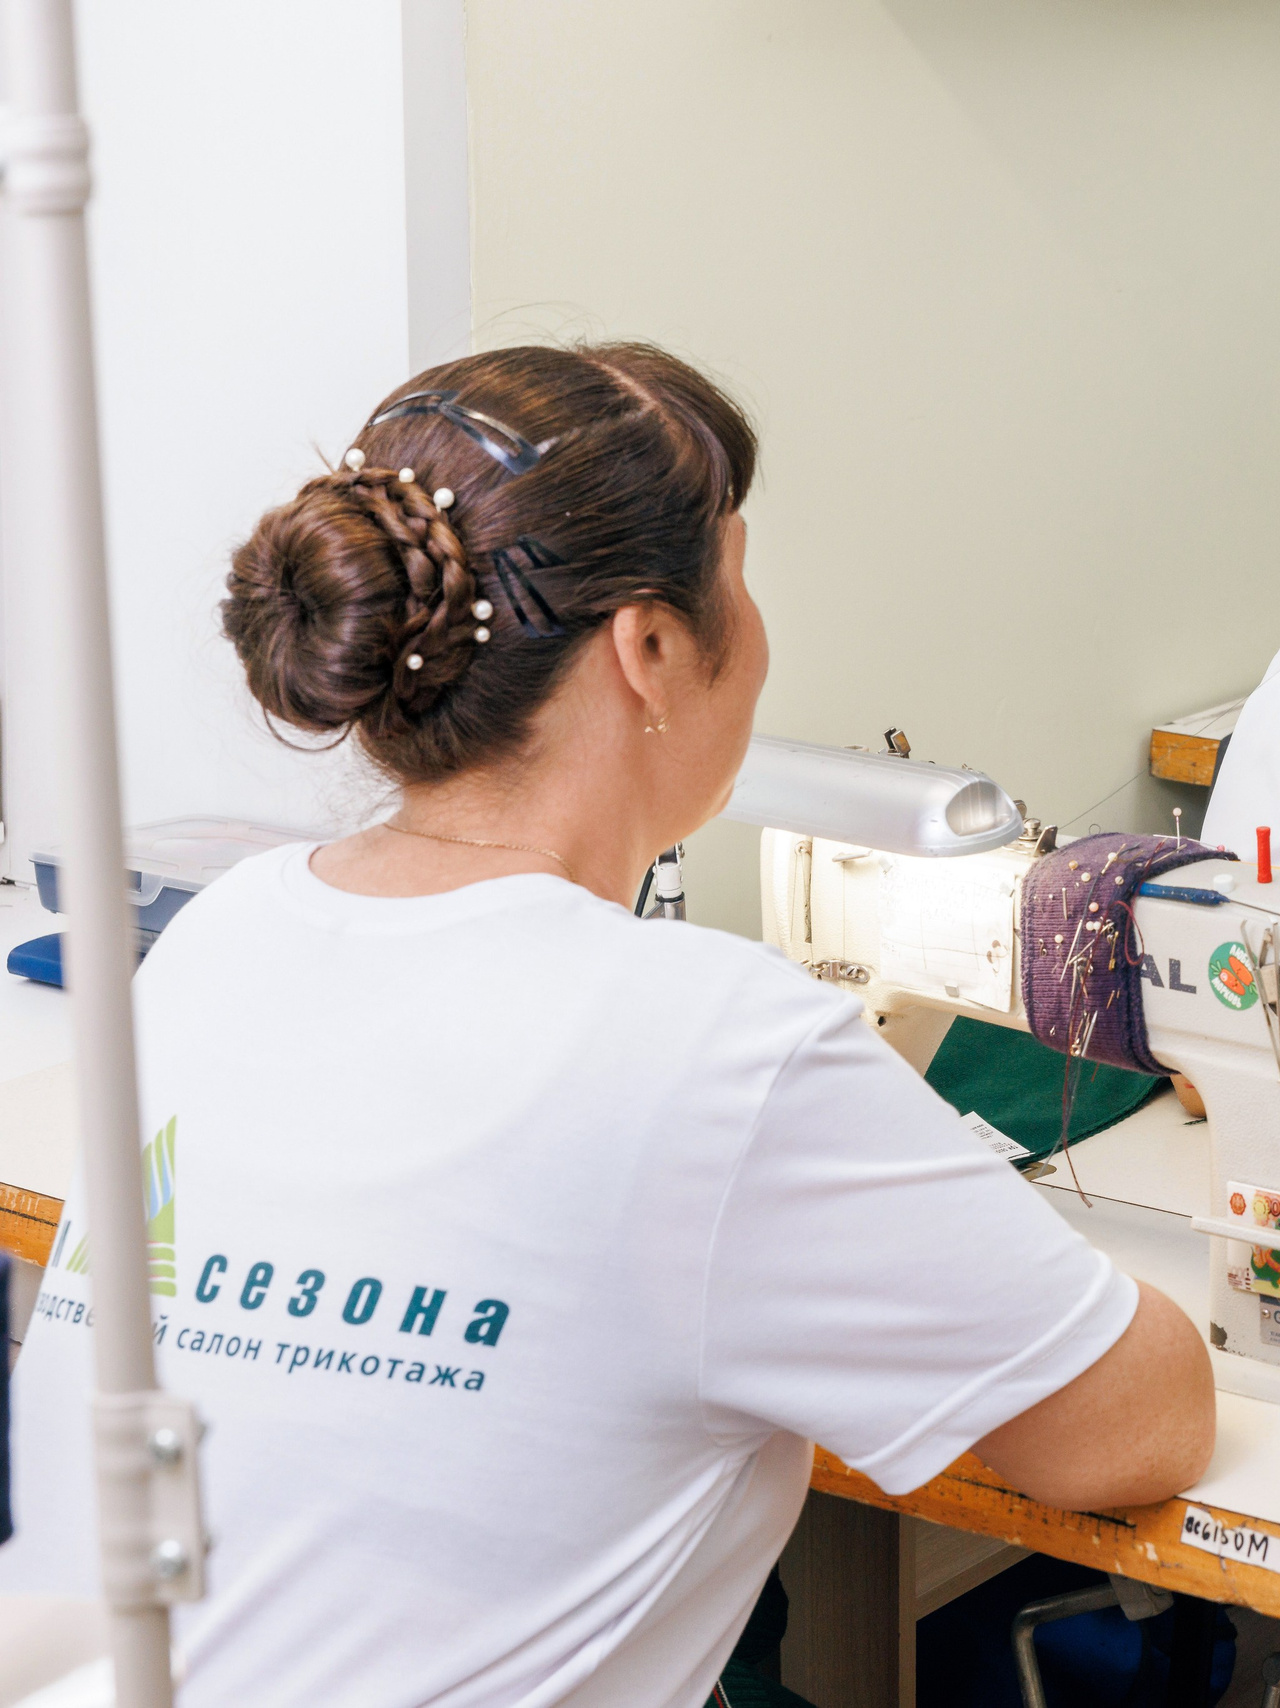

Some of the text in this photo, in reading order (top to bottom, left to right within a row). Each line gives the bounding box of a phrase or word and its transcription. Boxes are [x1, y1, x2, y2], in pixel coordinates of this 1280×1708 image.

[194, 1253, 511, 1348] сезона
[177, 1325, 261, 1362] салон
[275, 1340, 487, 1393] трикотажа
